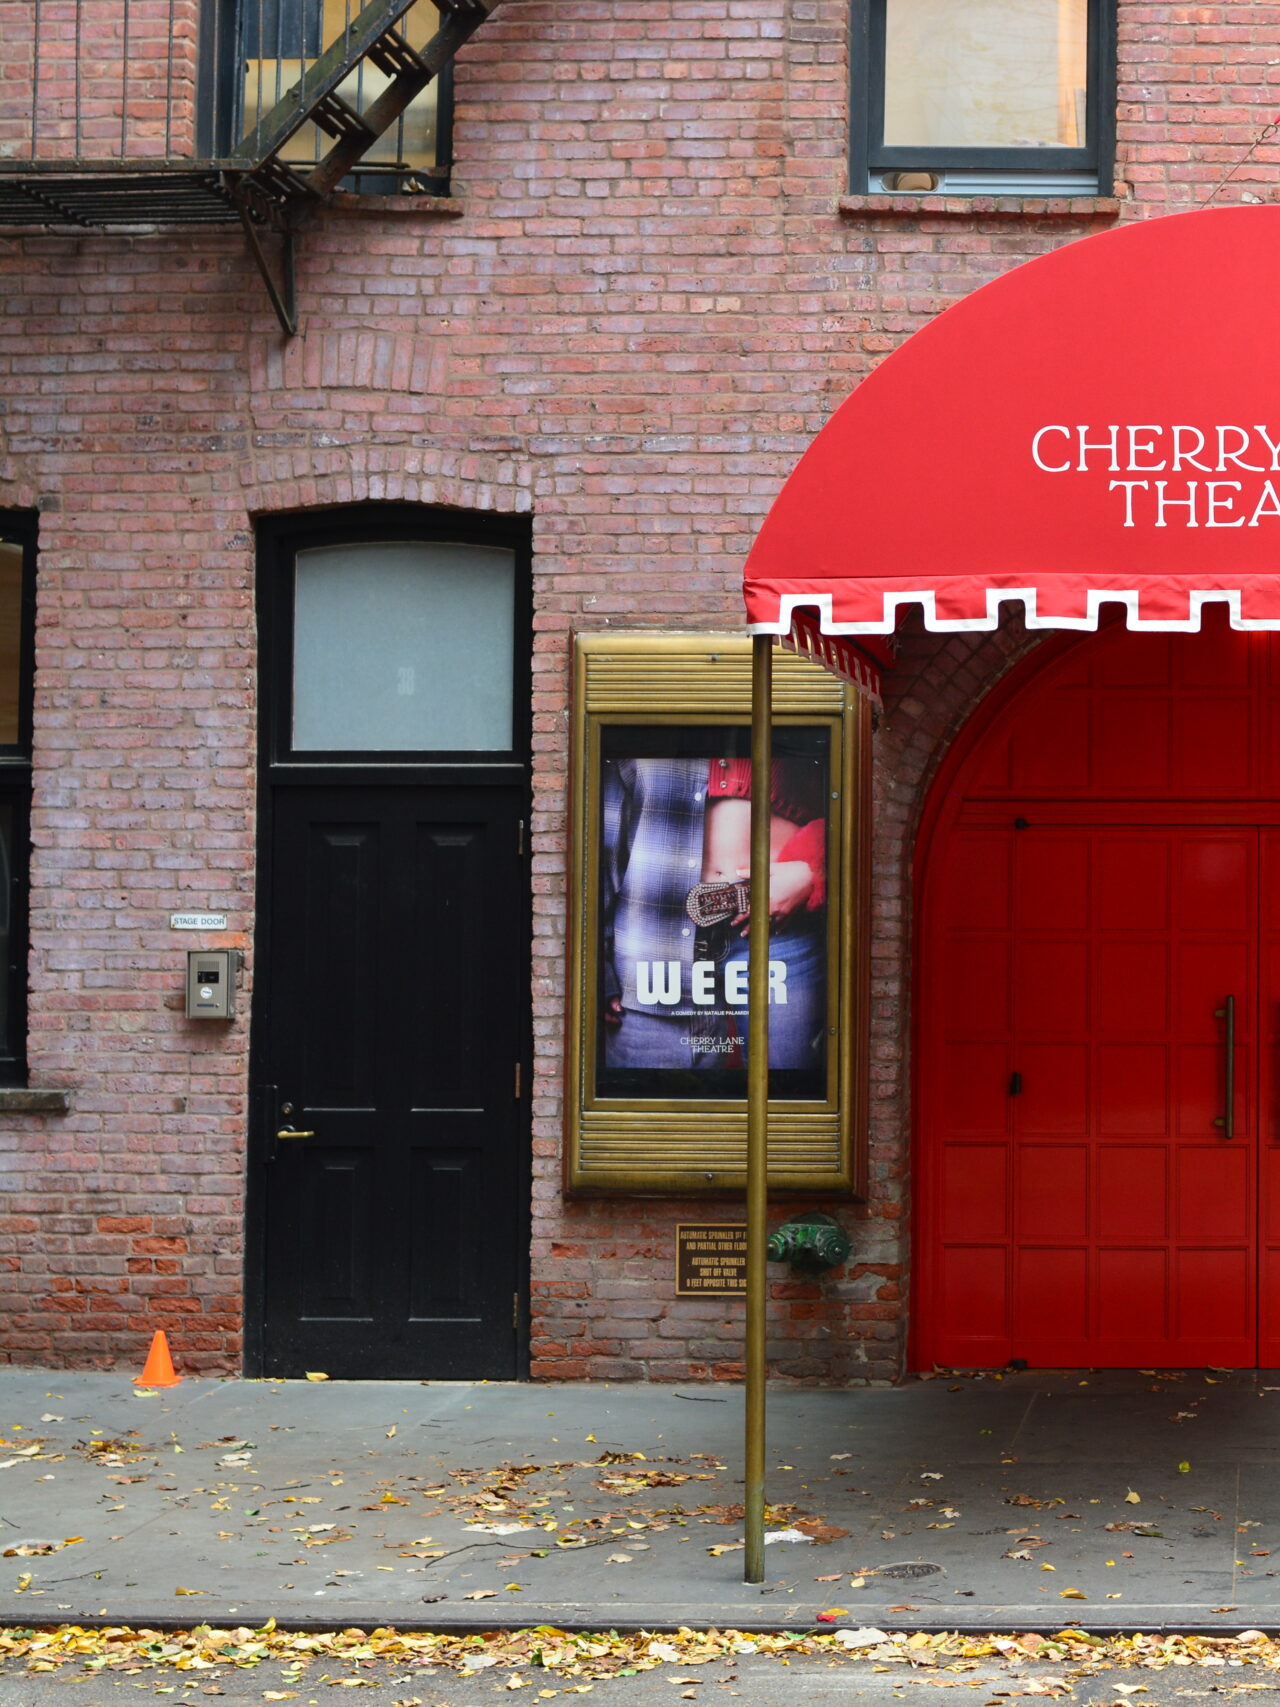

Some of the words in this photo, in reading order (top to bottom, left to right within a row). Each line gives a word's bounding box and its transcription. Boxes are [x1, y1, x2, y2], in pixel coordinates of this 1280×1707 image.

[174, 917, 198, 925] STAGE
[636, 960, 788, 1005] WEER
[680, 1037, 716, 1045] CHERRY
[719, 1037, 745, 1045] LANE
[691, 1045, 734, 1053] THEATRE
